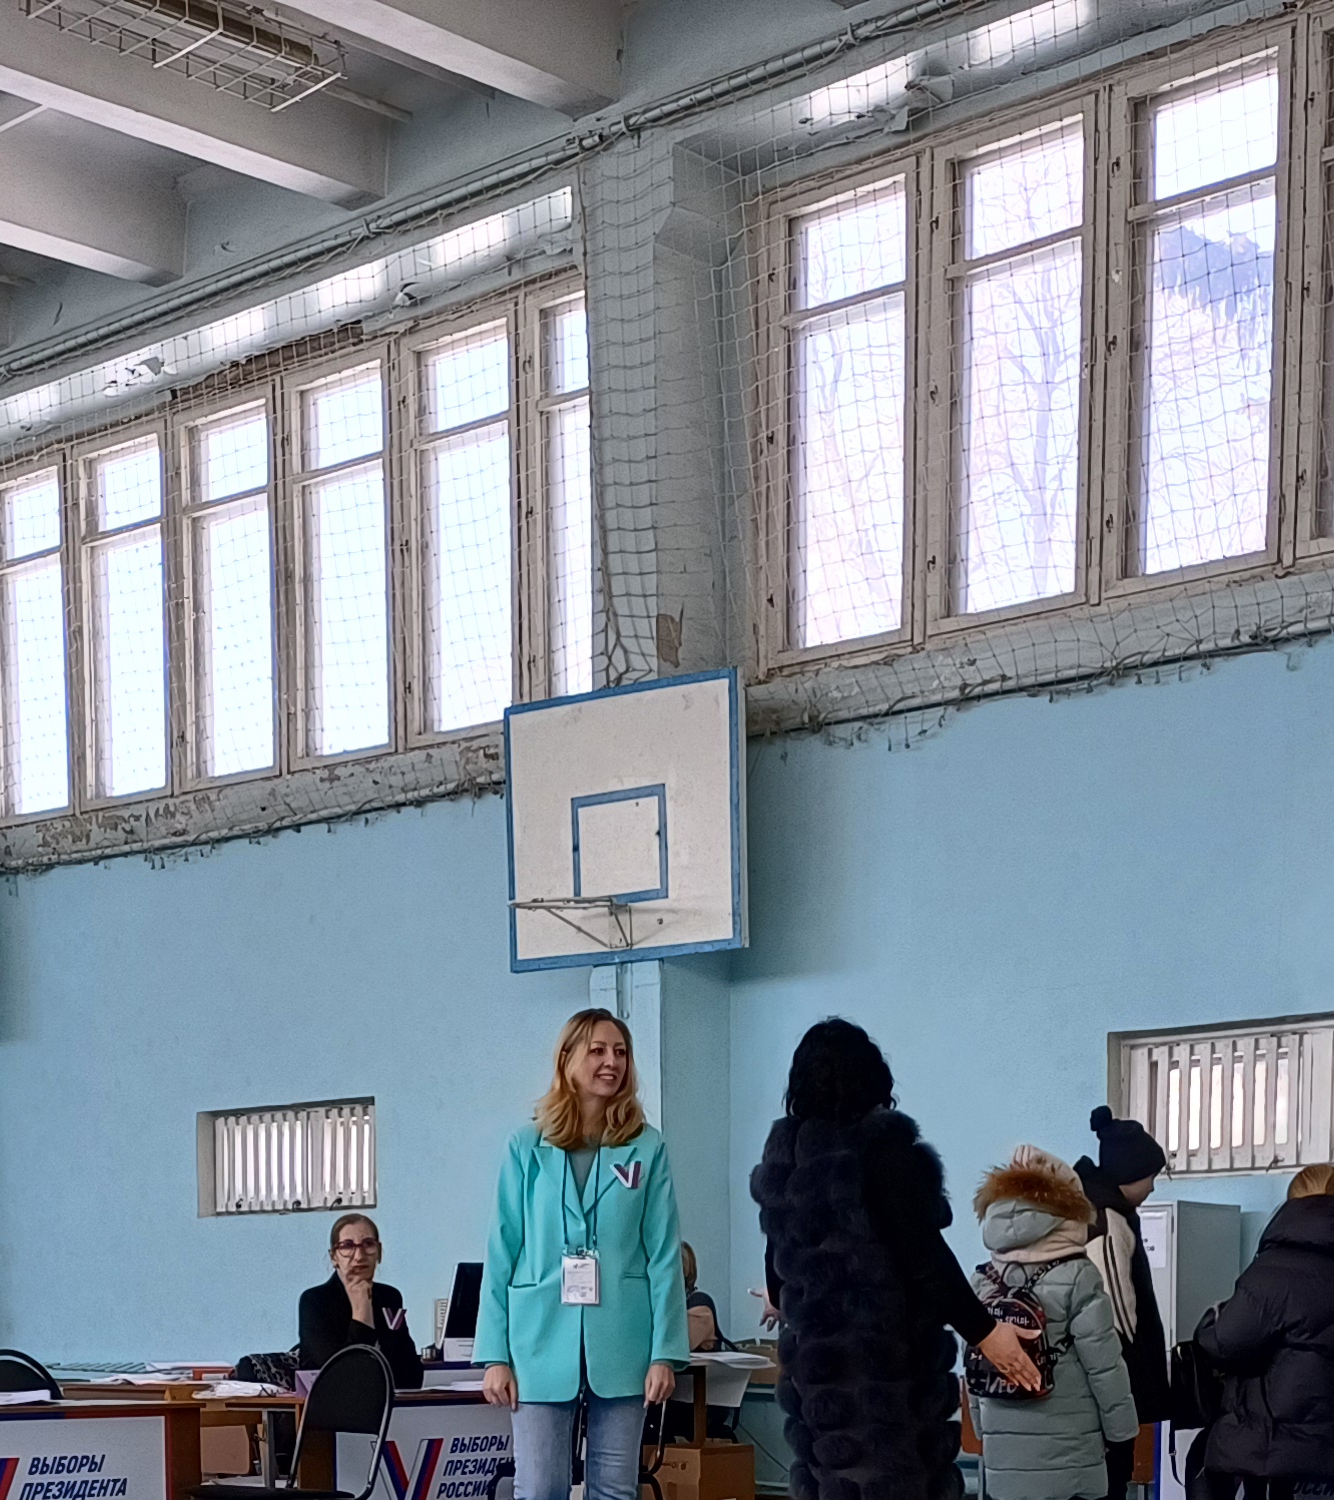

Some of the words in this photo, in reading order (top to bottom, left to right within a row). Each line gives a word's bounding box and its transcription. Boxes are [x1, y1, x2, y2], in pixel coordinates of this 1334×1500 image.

[449, 1435, 510, 1454] ВЫБОРЫ
[28, 1454, 106, 1475] ВЫБОРЫ
[443, 1457, 516, 1476] ПРЕЗИД
[19, 1478, 127, 1500] ПРЕЗИДЕНТА
